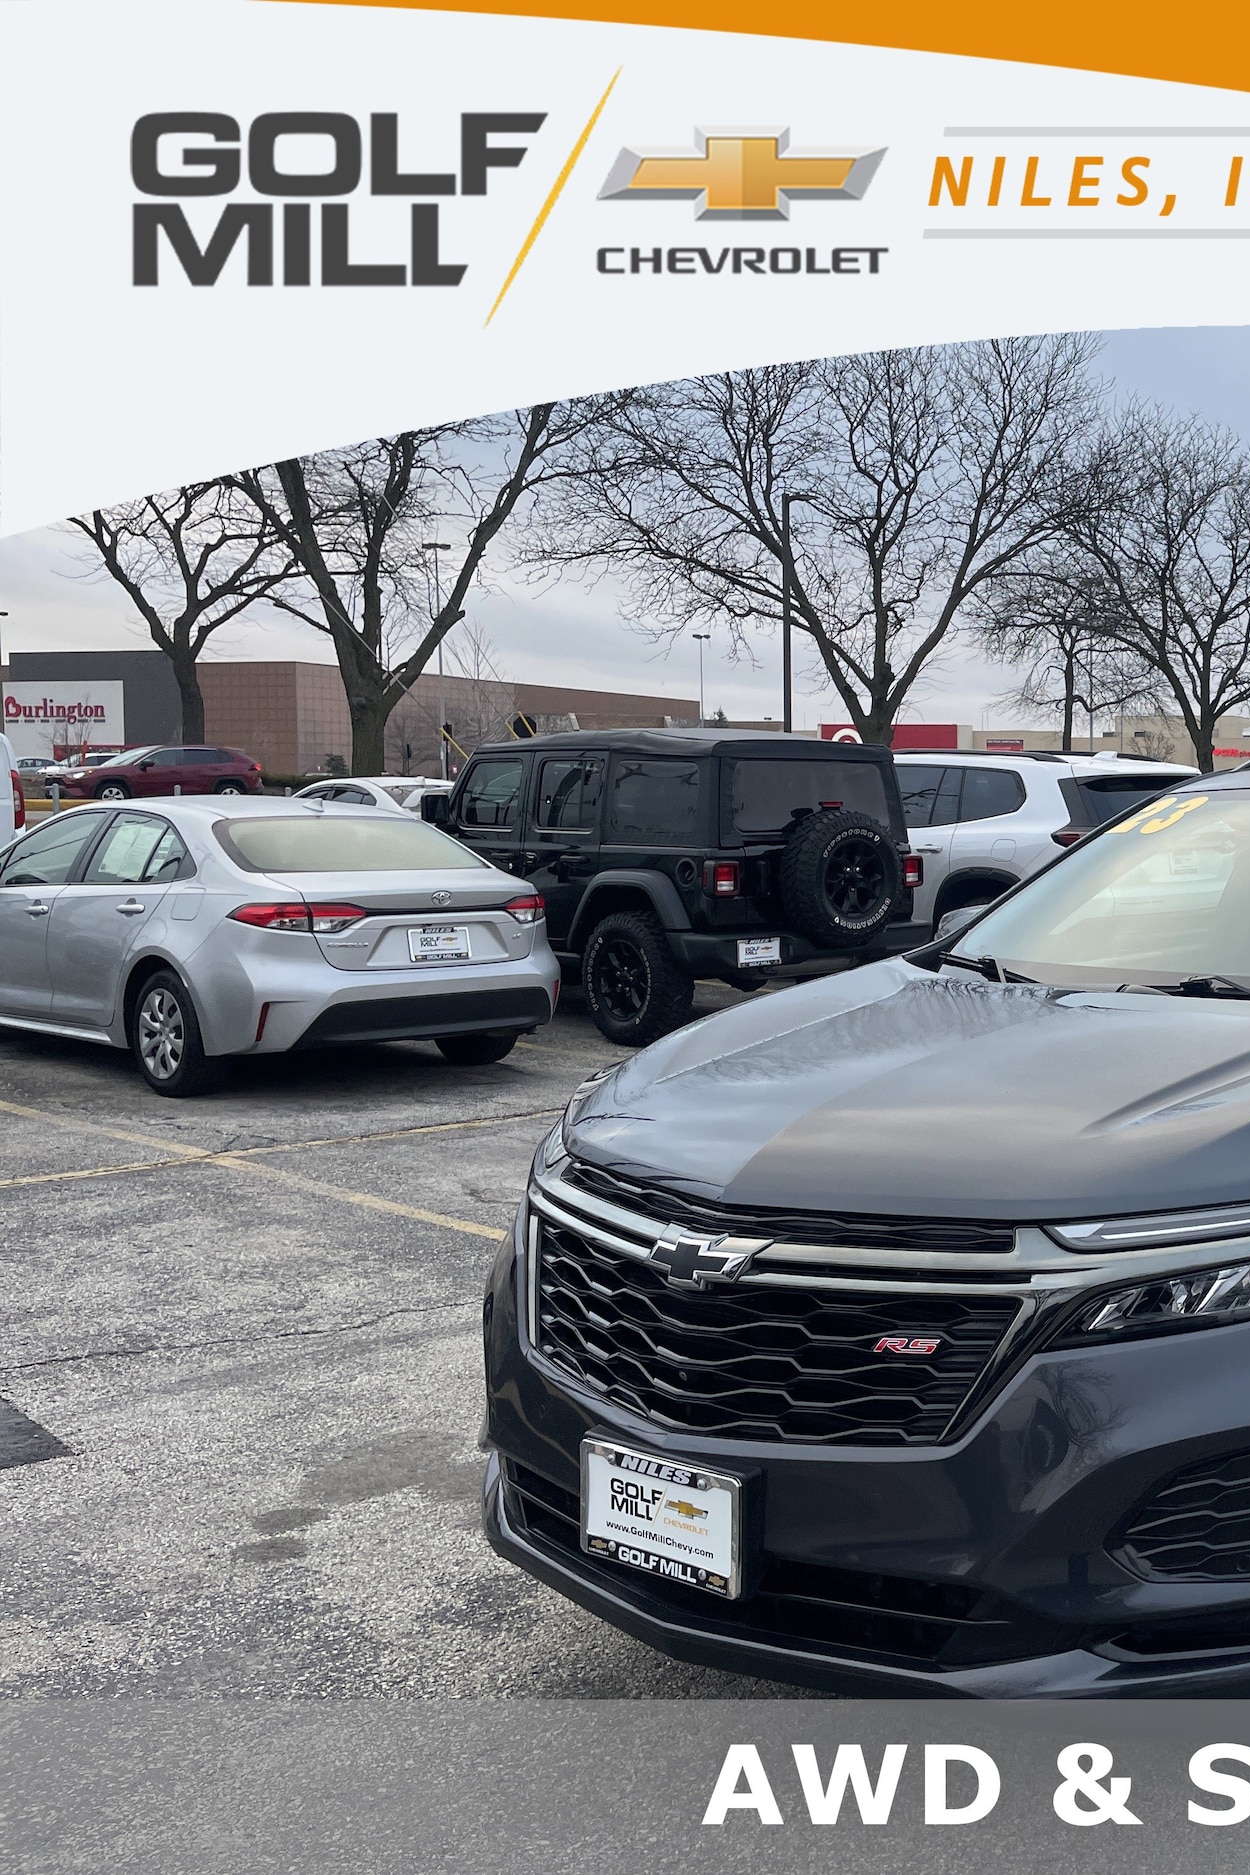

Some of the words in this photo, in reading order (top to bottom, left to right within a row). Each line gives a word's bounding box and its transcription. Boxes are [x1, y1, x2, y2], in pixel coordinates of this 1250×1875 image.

[5, 696, 105, 724] Burlington
[1104, 796, 1209, 834] 23
[873, 1337, 941, 1354] RS
[620, 1454, 692, 1485] NILES
[610, 1477, 663, 1506] GOLF
[611, 1494, 653, 1521] MILL
[606, 1520, 714, 1560] www.GolfMillChevy.com
[663, 1517, 710, 1536] CHEVROLET
[618, 1546, 659, 1570] GOLF
[659, 1557, 697, 1584] MILL
